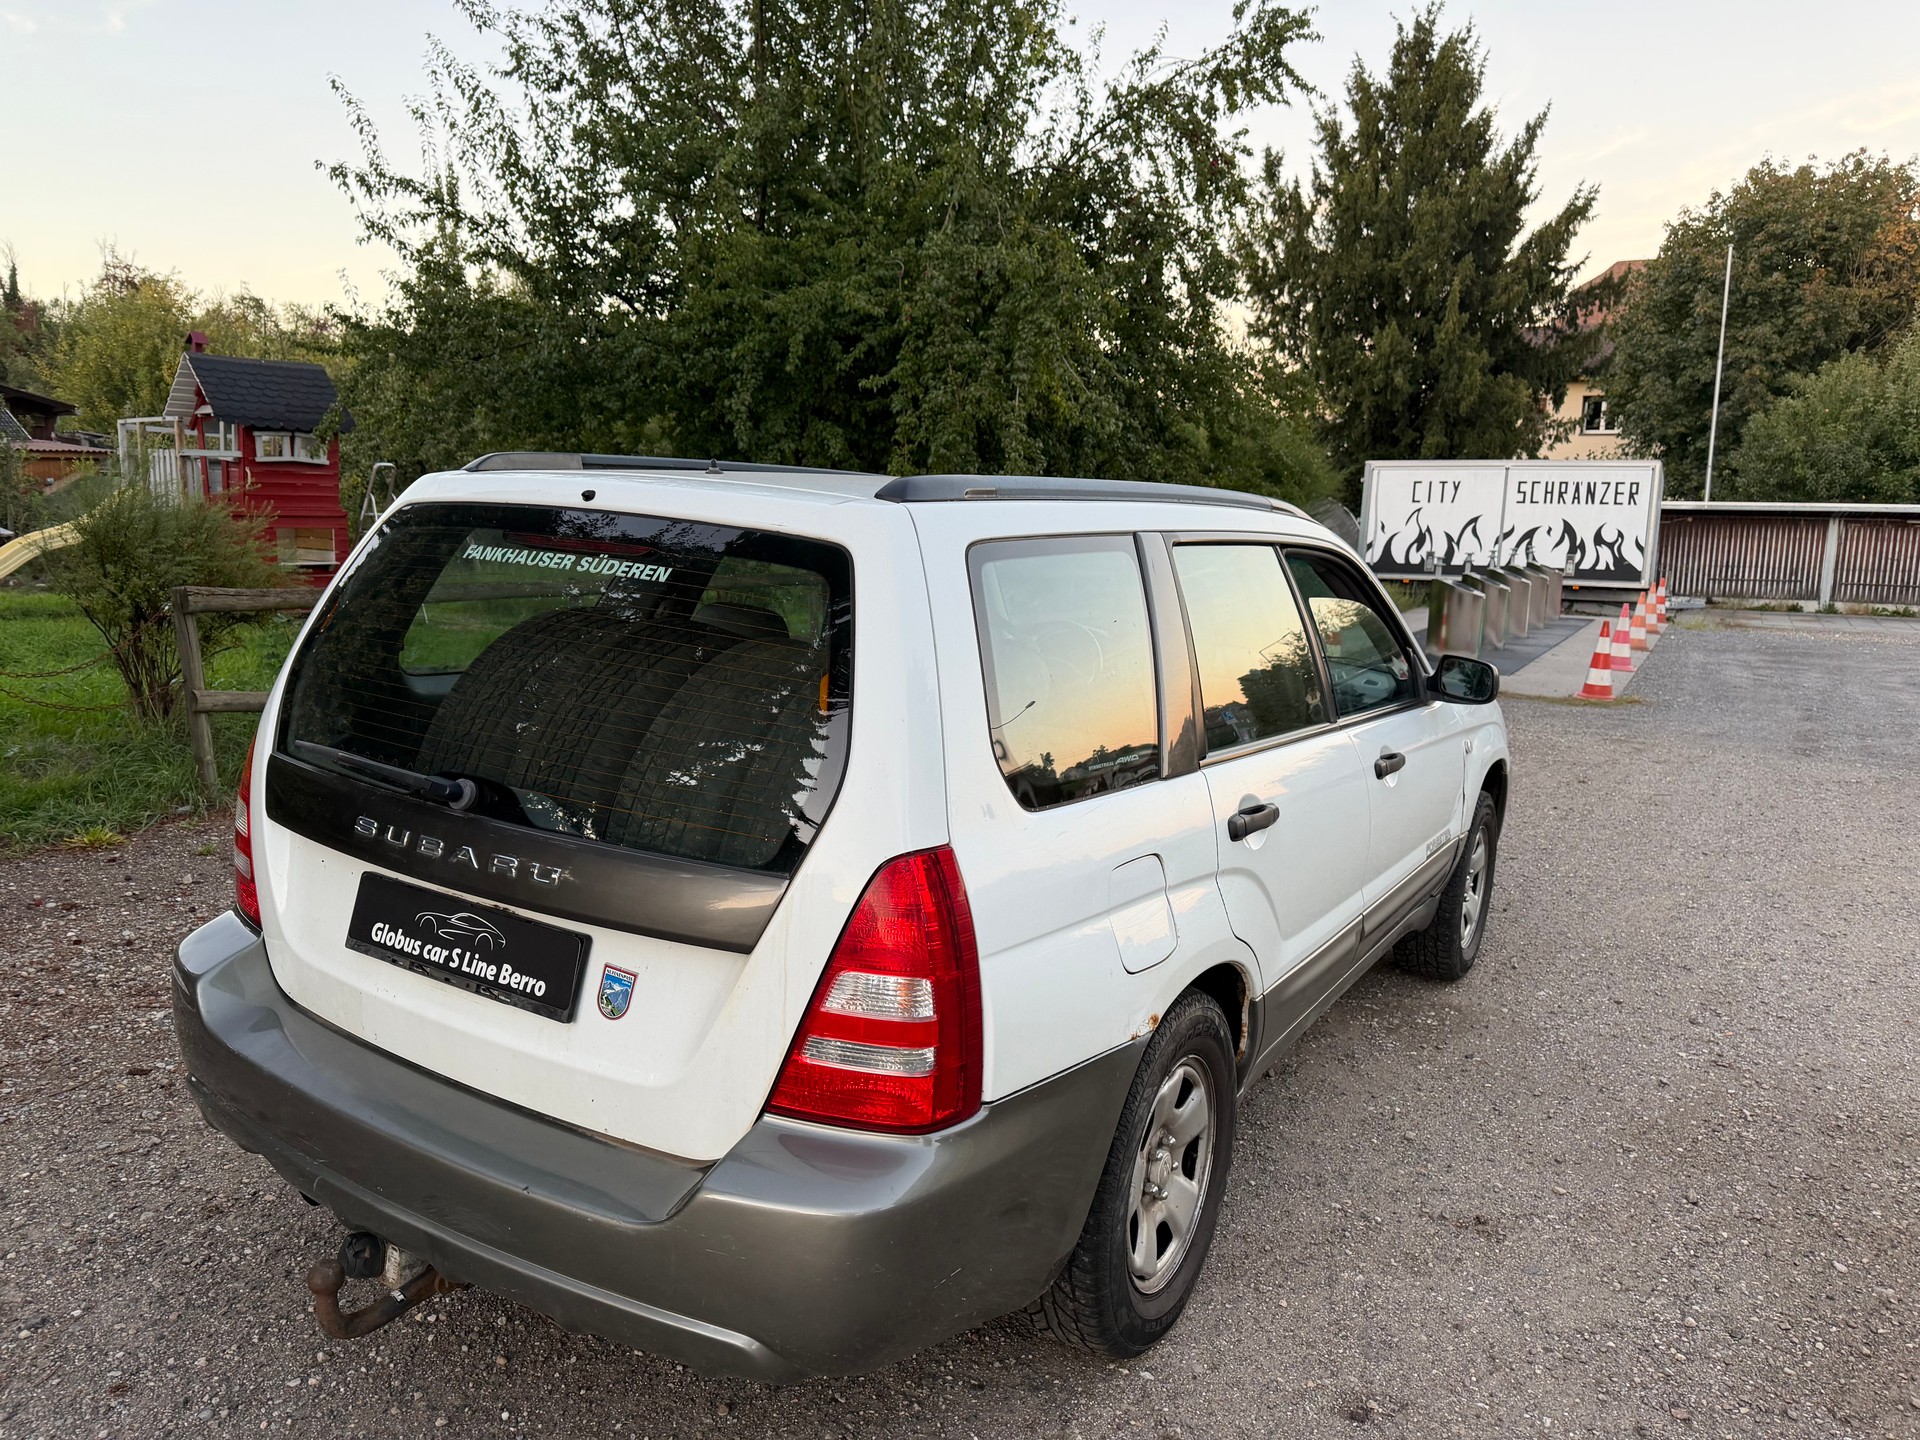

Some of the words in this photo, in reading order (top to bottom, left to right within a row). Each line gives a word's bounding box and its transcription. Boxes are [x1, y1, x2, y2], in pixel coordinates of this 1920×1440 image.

[1411, 480, 1462, 504] CITY
[1516, 480, 1640, 506] SCHRÄNZER
[462, 544, 576, 571] FANKHAUSER
[576, 553, 673, 583] SÜDEREN
[1114, 754, 1140, 765] AWD
[354, 815, 564, 887] SUBARU
[371, 922, 423, 957] Globus
[422, 943, 449, 965] car
[448, 948, 460, 968] S
[461, 952, 498, 981] Line
[497, 963, 547, 997] Berro
